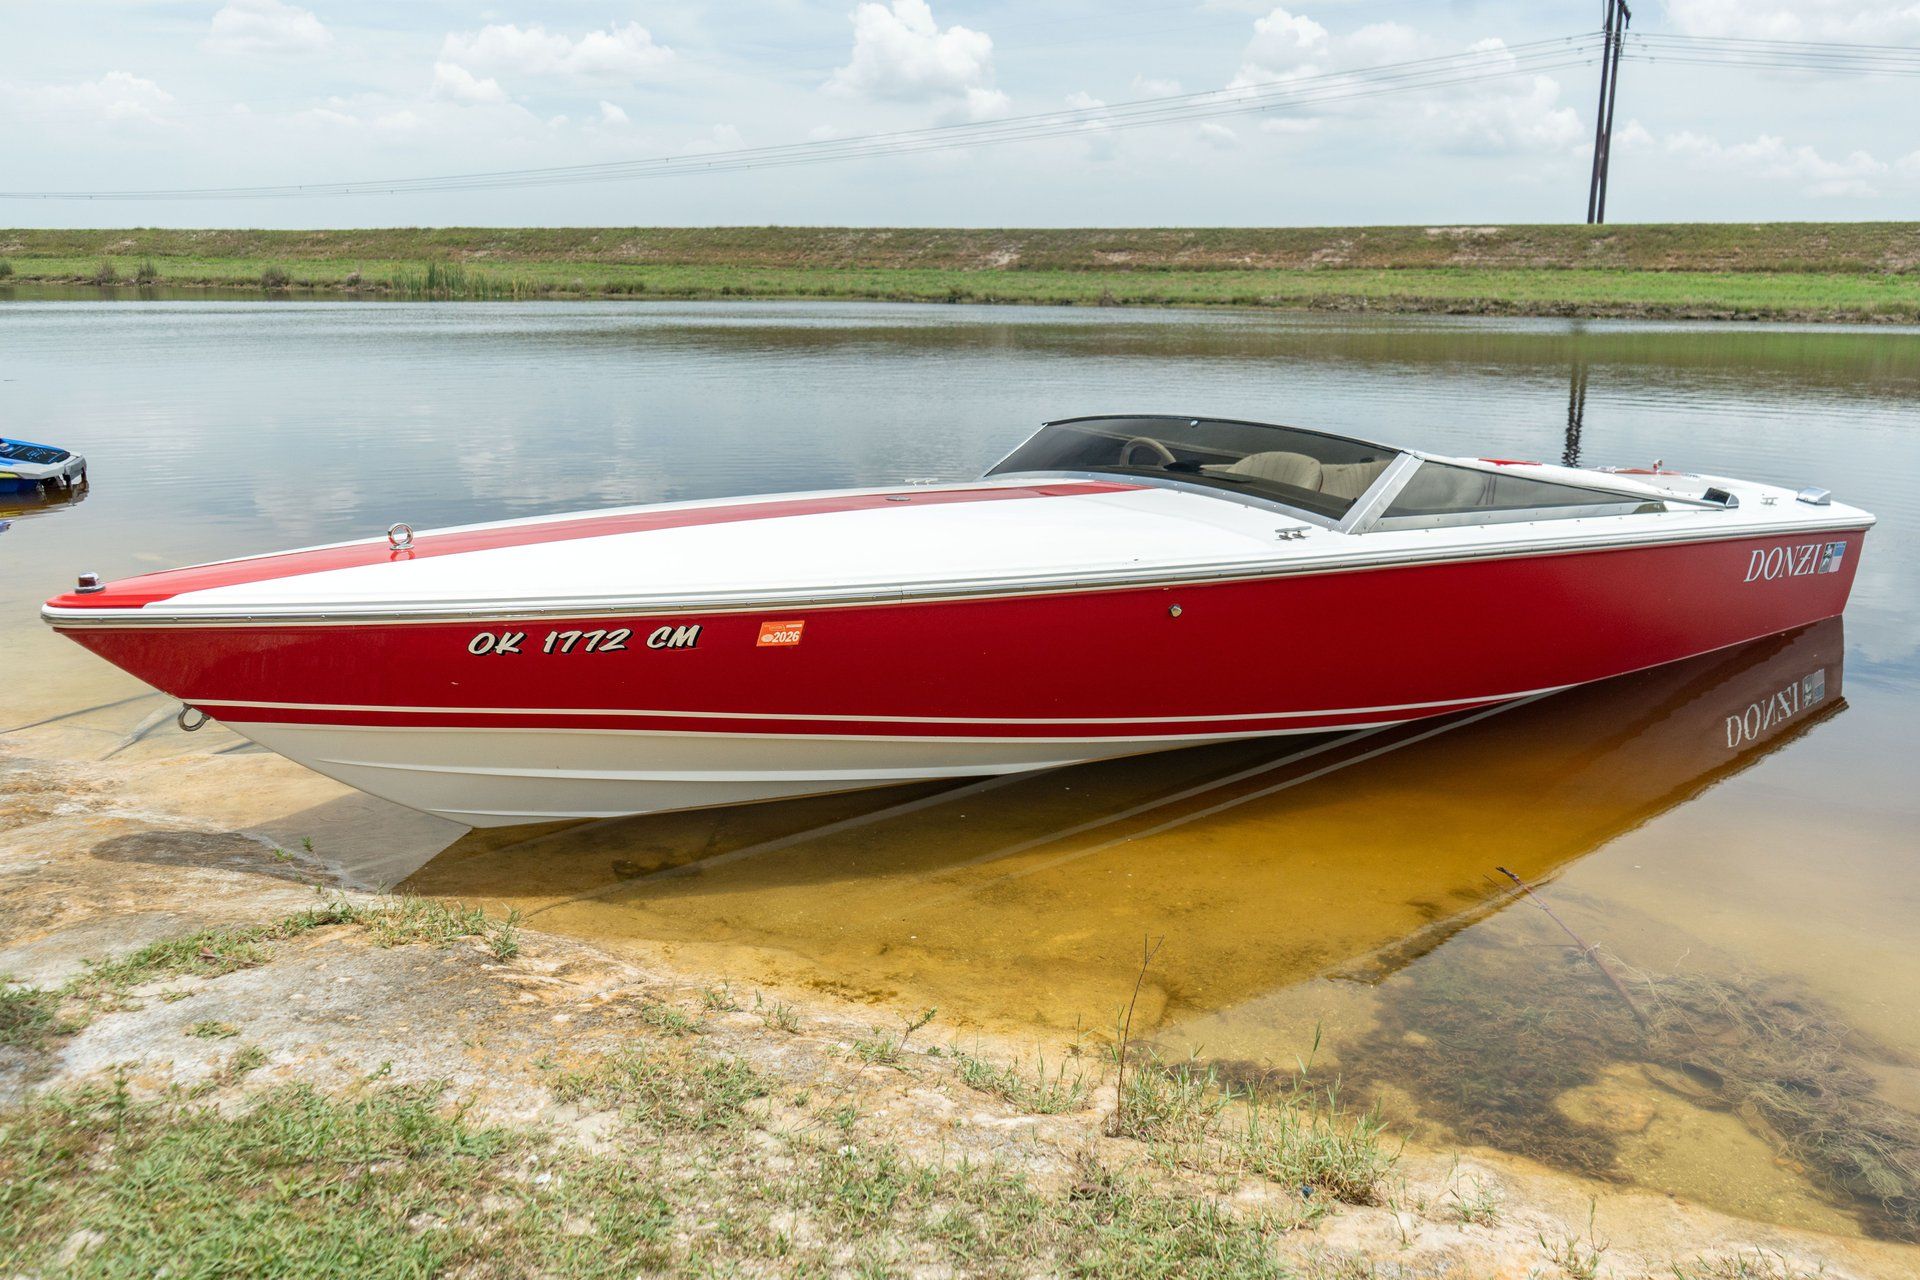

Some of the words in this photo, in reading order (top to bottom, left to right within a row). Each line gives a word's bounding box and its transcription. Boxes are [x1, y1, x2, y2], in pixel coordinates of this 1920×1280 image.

[1744, 544, 1822, 582] DONZI
[467, 631, 526, 655] OK
[543, 628, 635, 654] 1772
[646, 624, 703, 649] CM
[772, 630, 800, 643] 2026
